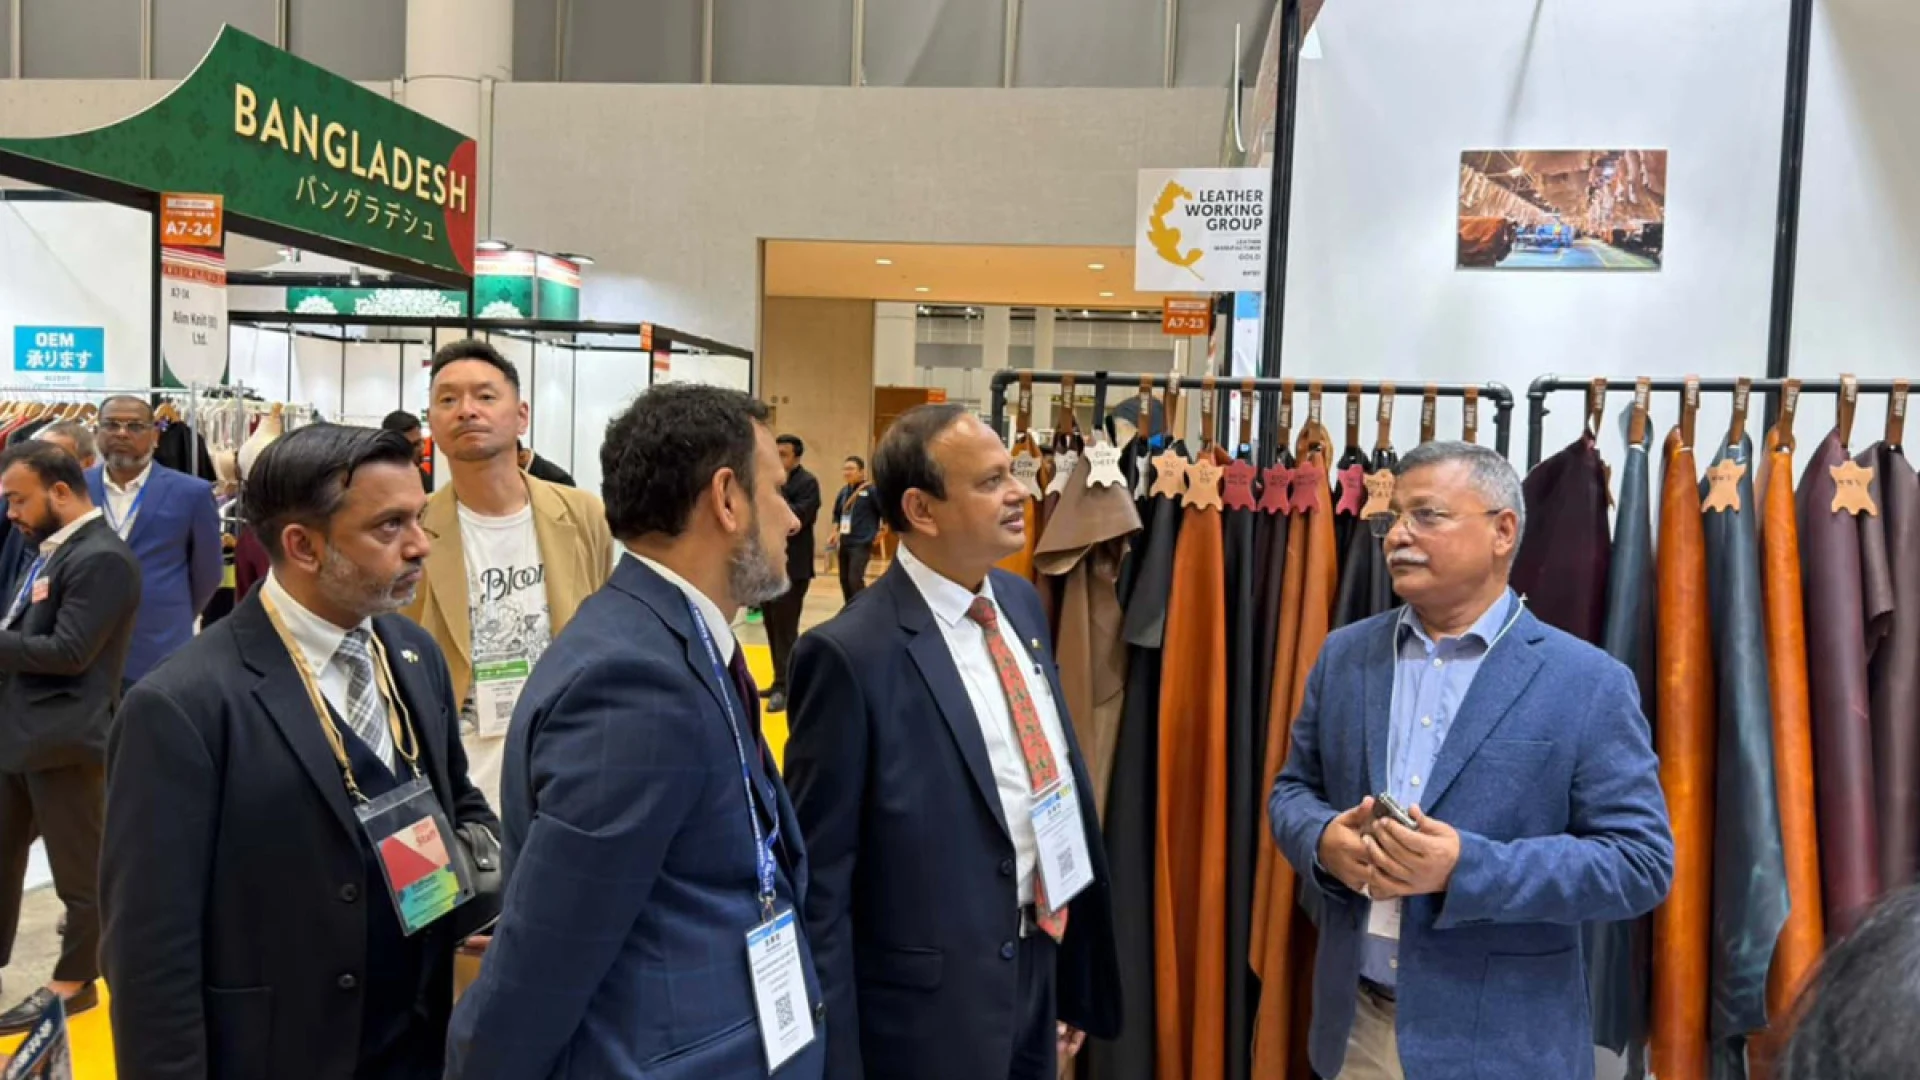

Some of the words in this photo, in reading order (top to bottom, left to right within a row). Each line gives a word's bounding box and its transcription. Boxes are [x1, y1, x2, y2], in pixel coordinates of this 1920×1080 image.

[234, 82, 467, 213] BANGLADESH
[1199, 190, 1263, 202] LEATHER
[295, 175, 435, 241] バングラデシュ
[1185, 204, 1263, 217] WORKING
[165, 220, 213, 236] A7-24
[1206, 218, 1263, 231] GROUP
[1167, 317, 1204, 329] A7-23
[35, 332, 75, 347] OEM
[191, 331, 208, 346] Ltd.
[26, 349, 92, 369] 承ります
[480, 564, 545, 603] Bloo
